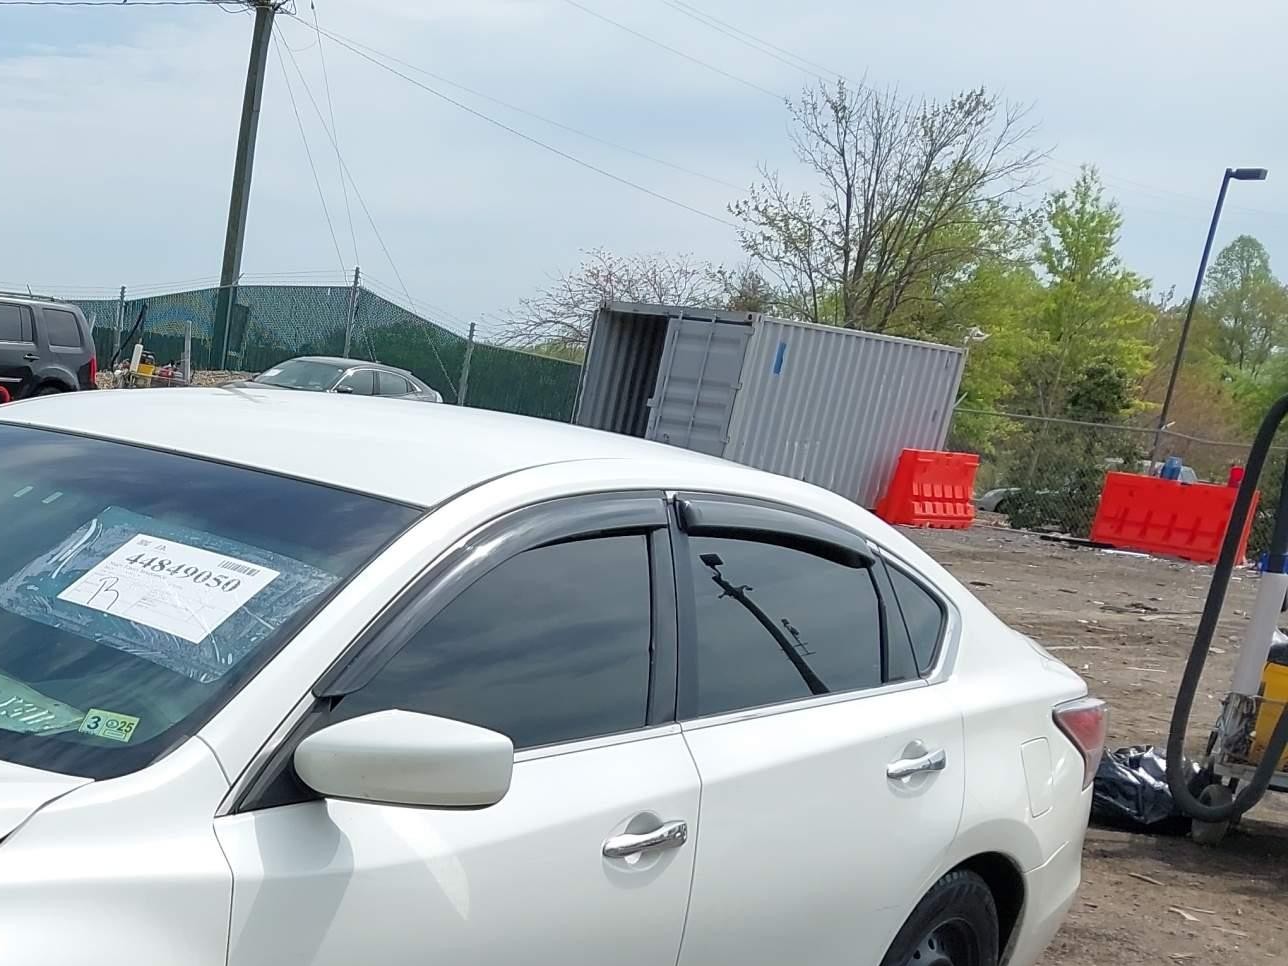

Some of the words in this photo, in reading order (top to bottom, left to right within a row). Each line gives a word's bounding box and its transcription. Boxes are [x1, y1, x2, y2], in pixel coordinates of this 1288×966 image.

[125, 553, 242, 593] 44849050
[86, 715, 102, 730] 3
[117, 720, 135, 733] 25
